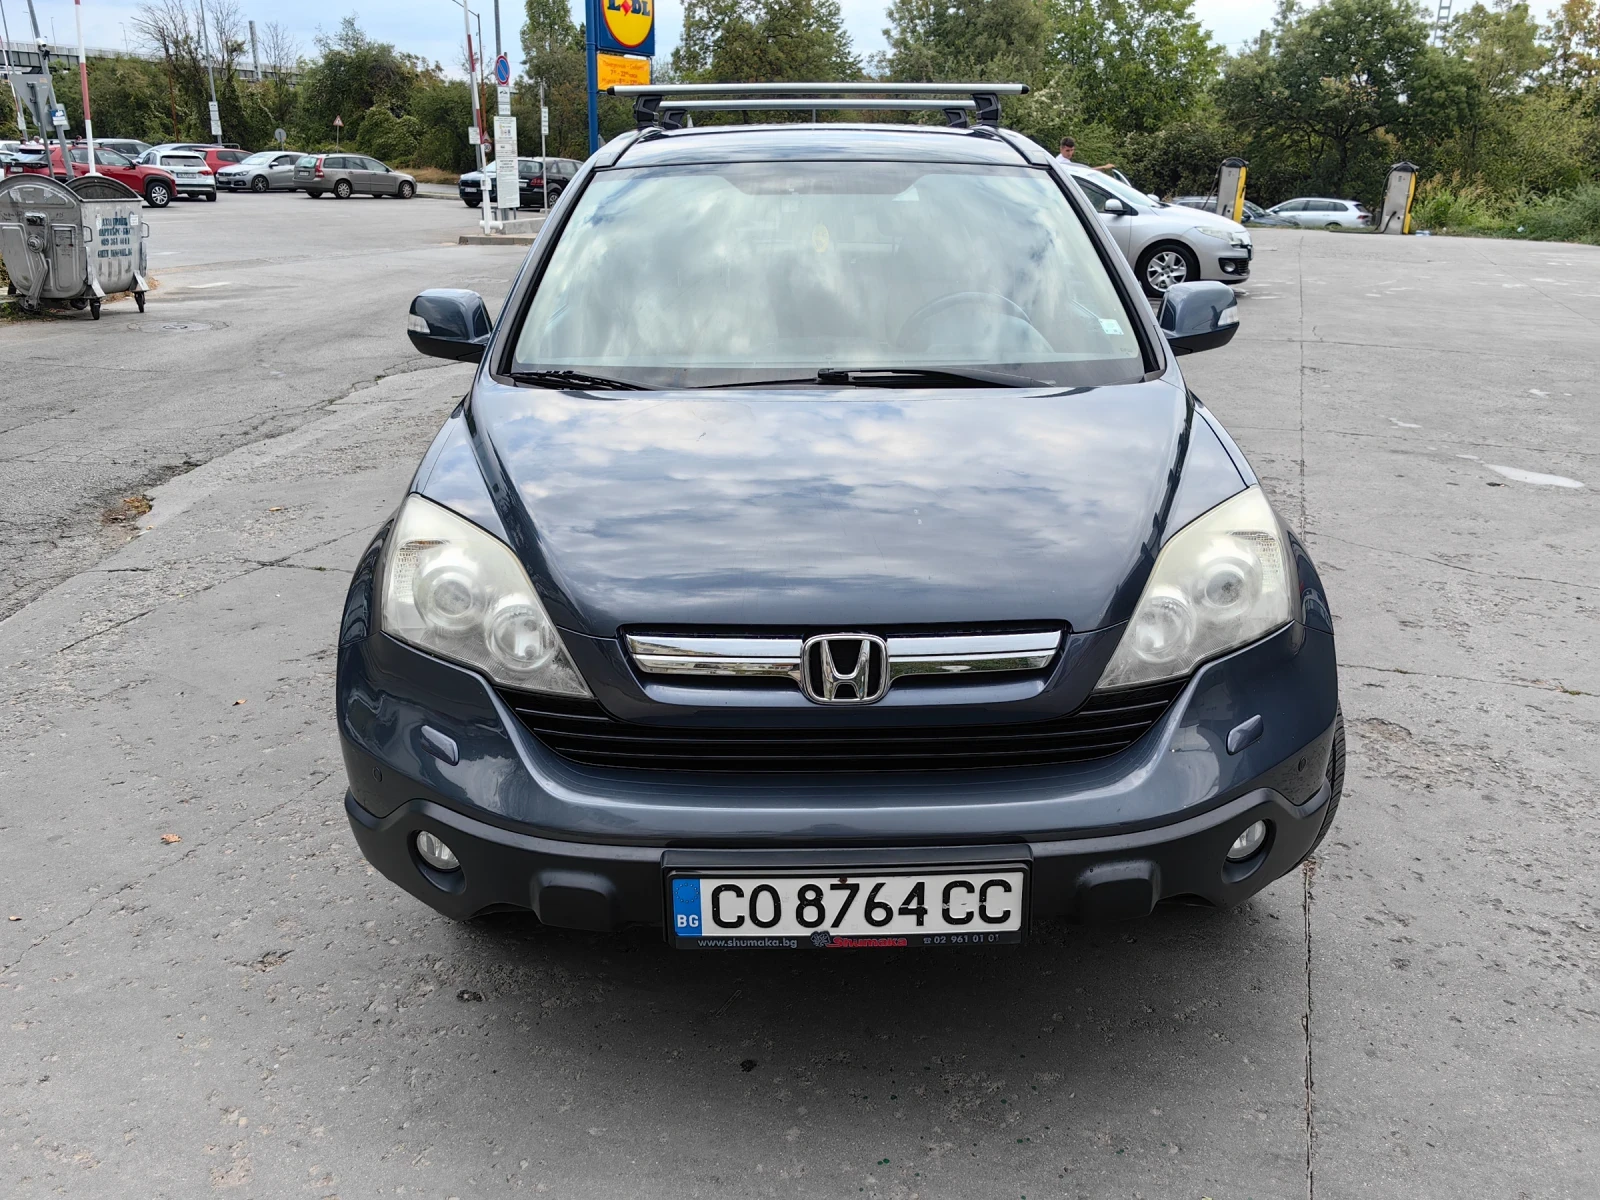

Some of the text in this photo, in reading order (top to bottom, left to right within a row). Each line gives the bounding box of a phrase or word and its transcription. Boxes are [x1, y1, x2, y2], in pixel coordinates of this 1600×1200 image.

[795, 881, 928, 929] 8764
[941, 878, 1012, 925] CC
[677, 914, 699, 928] BG
[698, 937, 798, 949] www.shumaka.bg
[826, 936, 907, 948] Shumaka
[934, 936, 946, 944] 02
[951, 935, 969, 944] 961
[972, 934, 984, 943] 01
